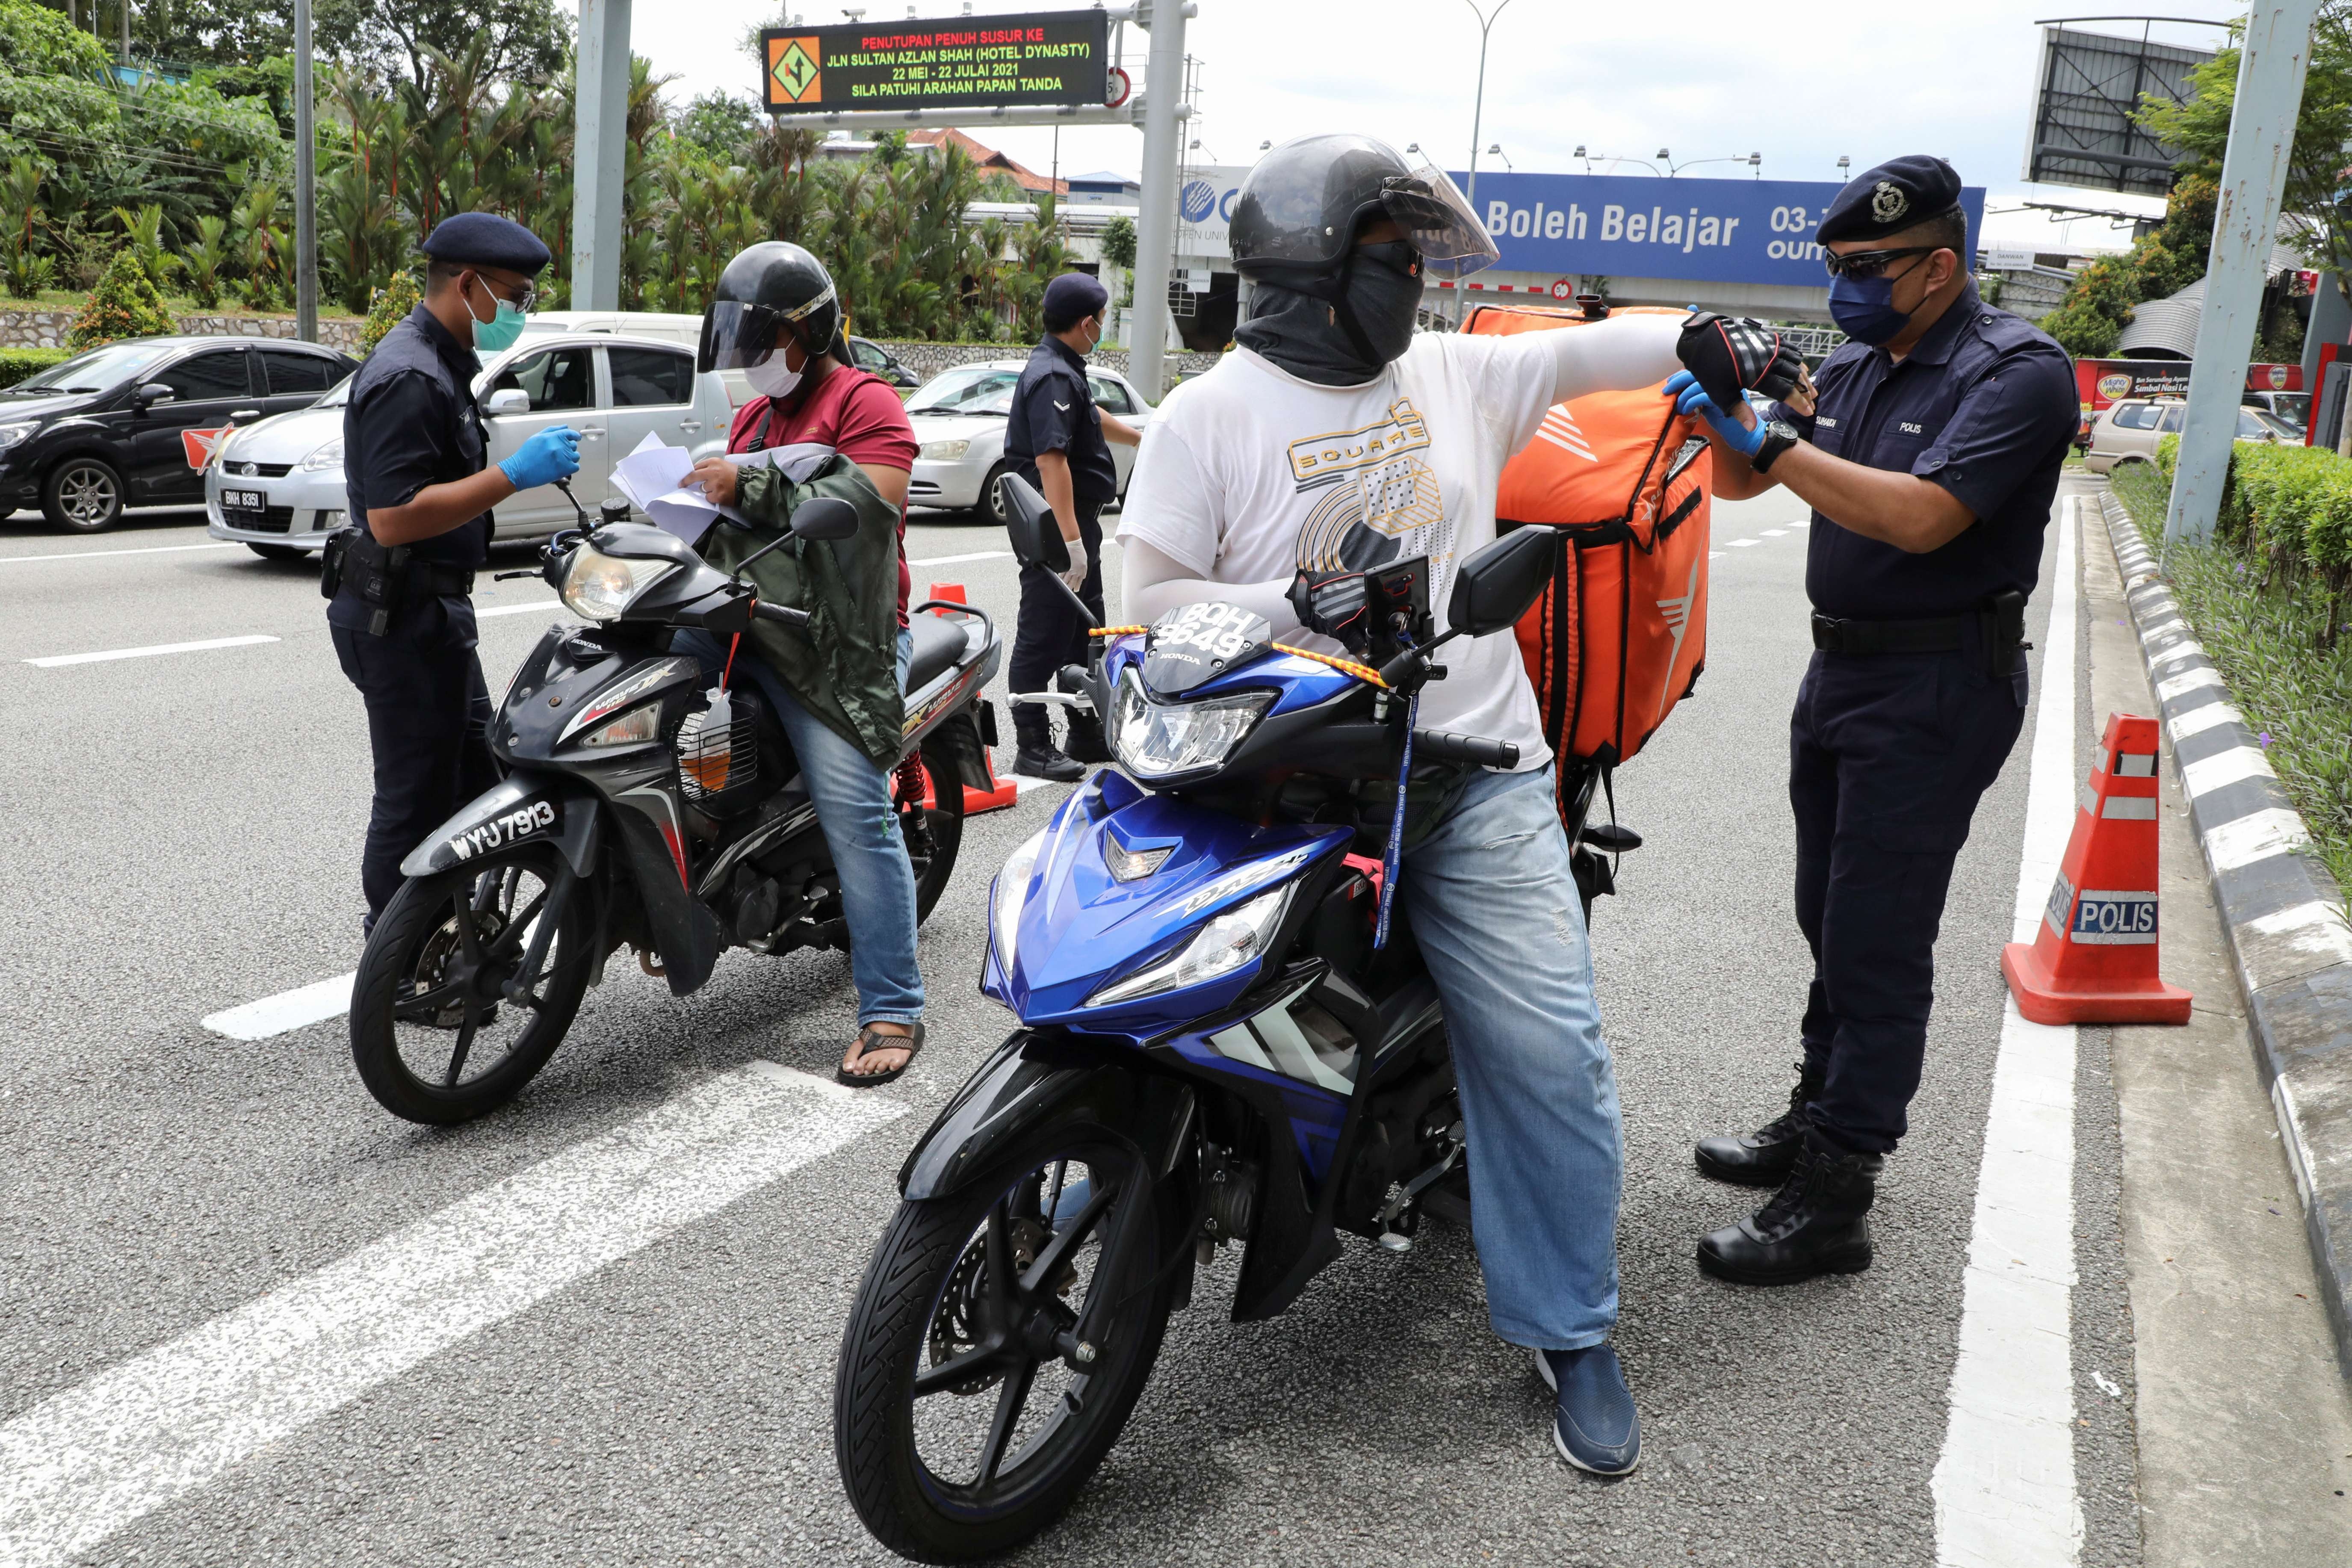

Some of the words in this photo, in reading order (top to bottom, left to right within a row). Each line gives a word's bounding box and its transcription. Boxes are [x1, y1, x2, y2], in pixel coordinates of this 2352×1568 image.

[862, 34, 932, 50] PENUTUPAN
[935, 32, 977, 46] PENUH
[980, 29, 1023, 44] SUSUR
[1027, 28, 1044, 41] KE
[827, 54, 848, 67] JLN
[851, 52, 895, 66] SULTAN
[898, 50, 936, 64] AZLAN
[940, 48, 972, 62] SHAH
[976, 46, 1022, 63] (HOTEL
[1026, 43, 1090, 59] DYNASTY)
[892, 68, 905, 80] 22
[908, 66, 928, 80] MEI
[938, 65, 952, 79] 22
[954, 64, 989, 78] JULAI
[992, 63, 1019, 76] 2021
[851, 84, 878, 97] SILA
[880, 82, 920, 96] PATUHI
[923, 80, 972, 95] ARAHAN
[977, 79, 1016, 93] PAPAN
[1020, 77, 1062, 91] TANDA
[1486, 200, 1588, 240] Boleh
[1601, 204, 1740, 253] Belajar
[1770, 206, 1830, 233] 03-
[2161, 384, 2178, 392] Nasi
[1899, 422, 1922, 434] POLIS
[1298, 425, 1424, 468] SQUARE
[225, 491, 240, 505] BKH
[242, 492, 259, 507] 8351
[1179, 602, 1256, 635] BQH
[570, 638, 603, 651] HONDA
[1152, 621, 1245, 658] 9649
[1159, 653, 1201, 665] HONDA
[595, 681, 641, 711] WAVE
[2080, 903, 2154, 932] POLIS
